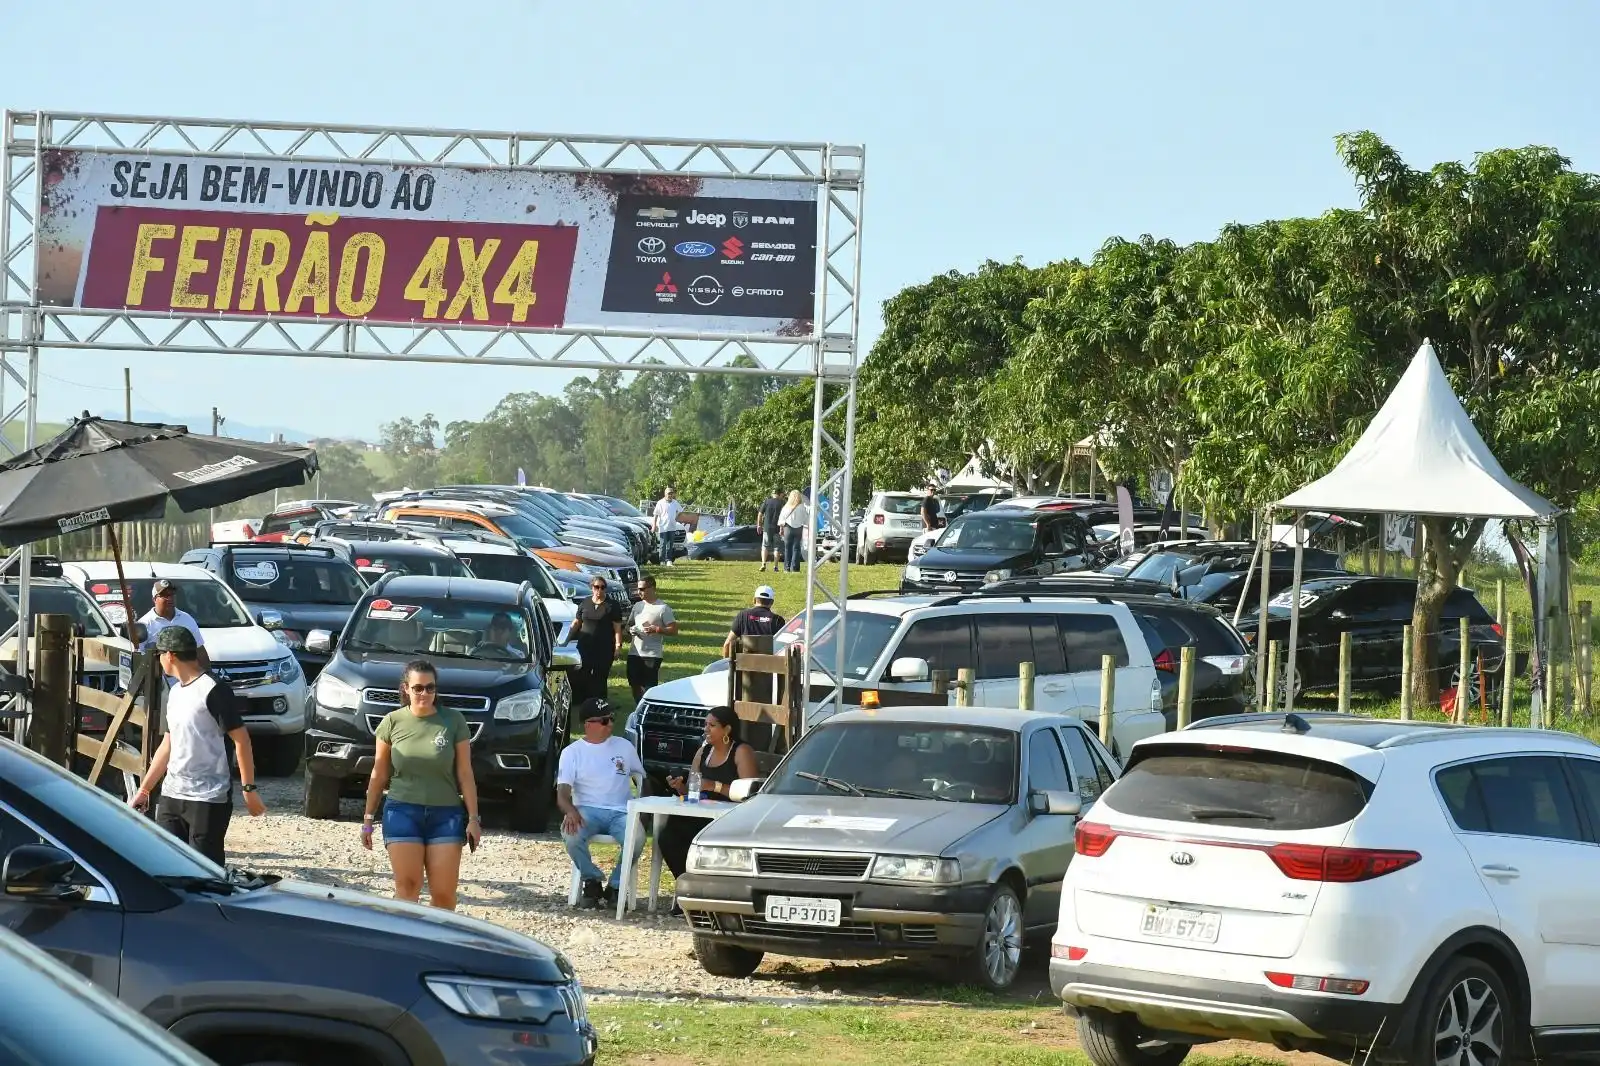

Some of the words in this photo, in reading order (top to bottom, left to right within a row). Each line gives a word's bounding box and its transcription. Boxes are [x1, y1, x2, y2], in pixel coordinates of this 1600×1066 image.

[111, 160, 188, 200] SEJA
[200, 165, 383, 208] BEM-VINDO
[391, 171, 434, 211] AO
[685, 209, 727, 228] Jeep
[751, 215, 795, 225] RAM
[125, 212, 386, 316] FEIRÃO
[403, 236, 538, 322] 4X4
[636, 255, 667, 263] TOYOTA
